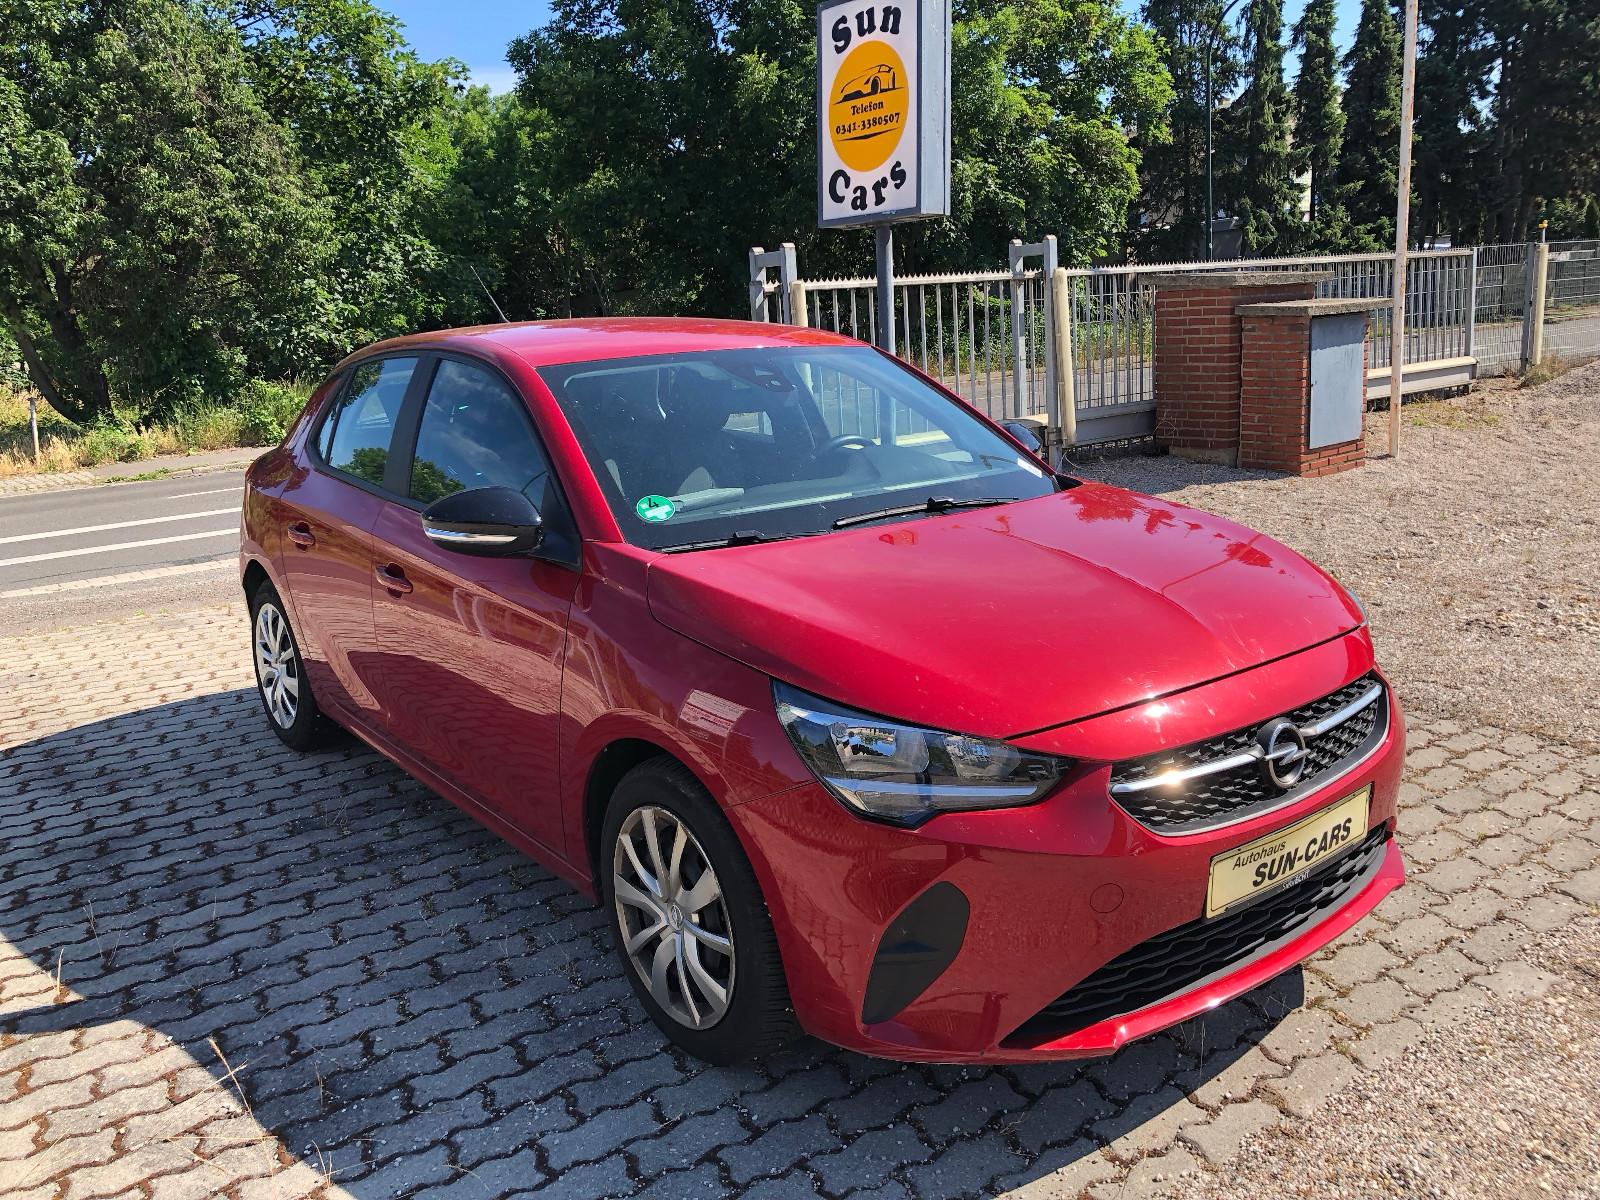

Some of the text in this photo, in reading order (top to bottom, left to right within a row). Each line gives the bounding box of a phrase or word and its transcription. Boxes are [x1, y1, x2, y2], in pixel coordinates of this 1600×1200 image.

[831, 5, 901, 54] Sun
[835, 112, 901, 135] 0341-3380507
[850, 100, 884, 116] Telefon
[828, 160, 907, 211] Cars
[1232, 841, 1286, 870] Autohaus
[1252, 817, 1352, 887] SUN-CARS
